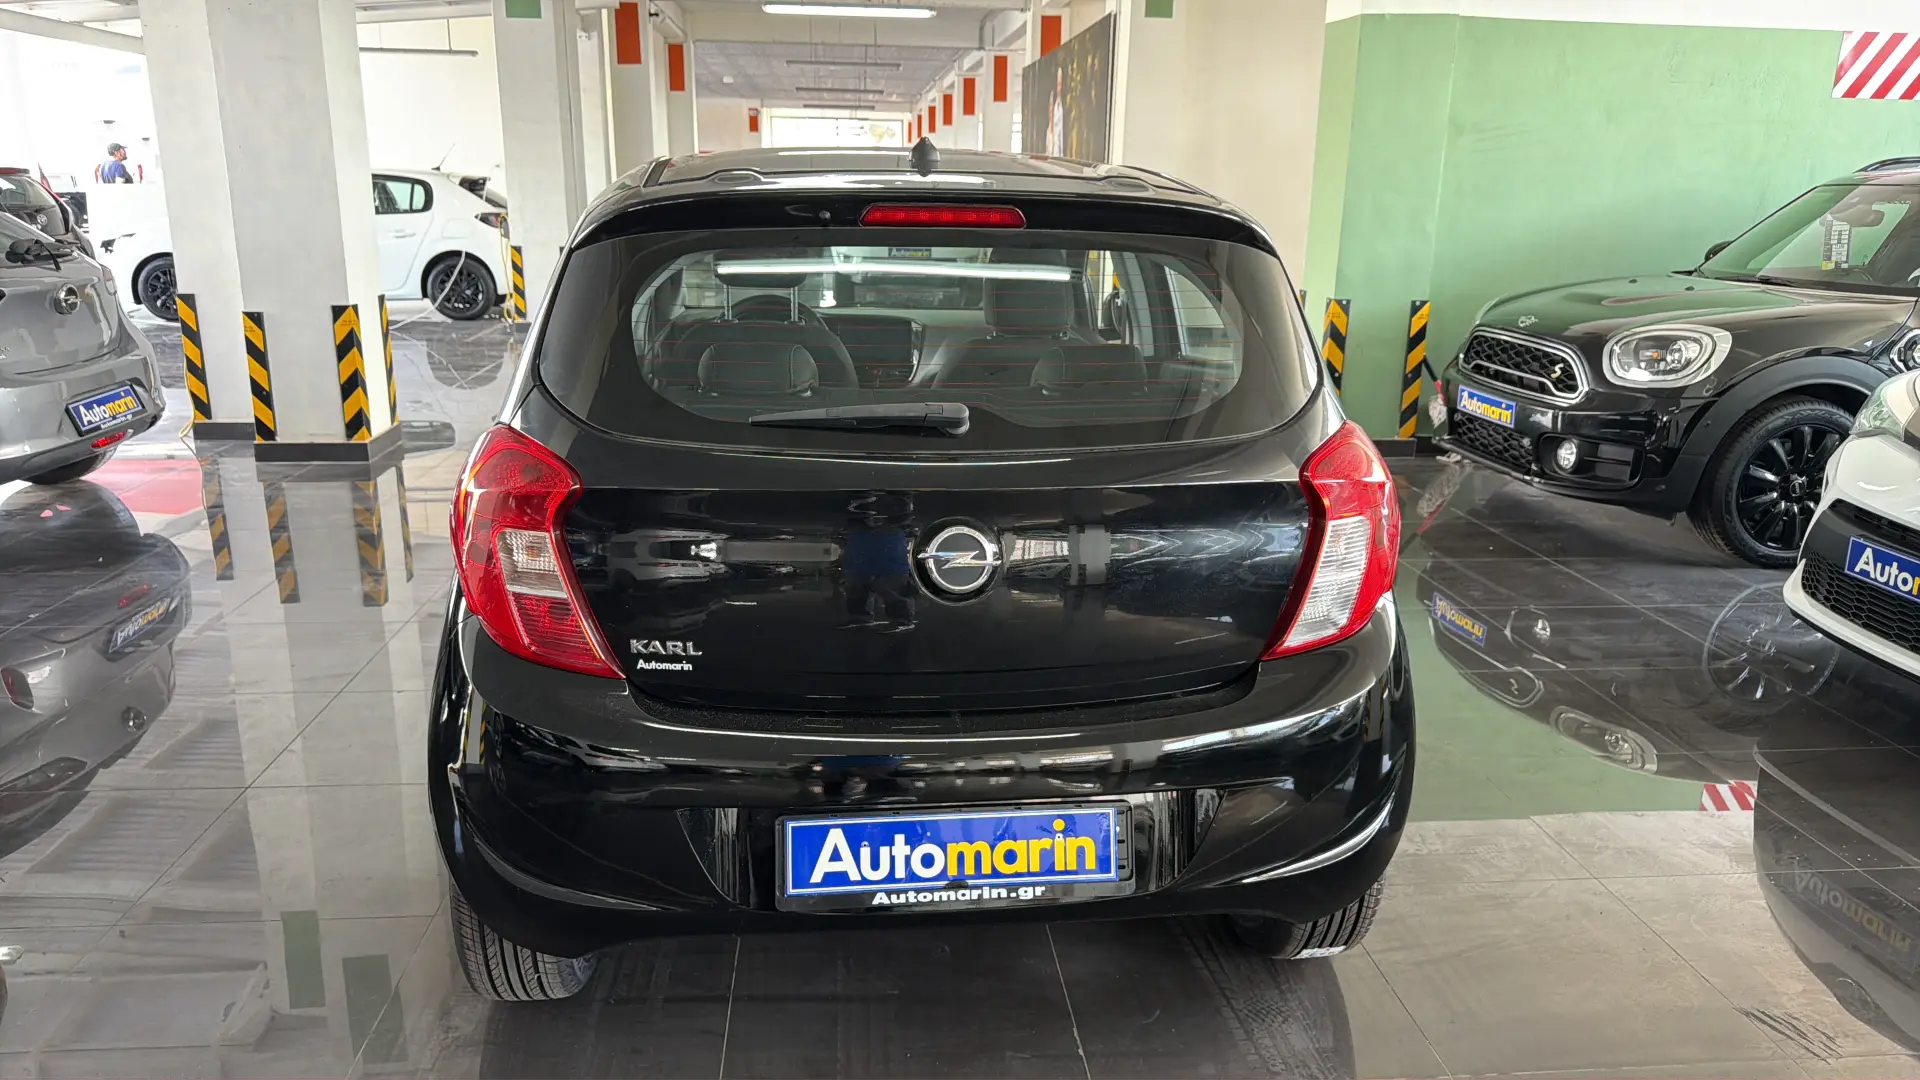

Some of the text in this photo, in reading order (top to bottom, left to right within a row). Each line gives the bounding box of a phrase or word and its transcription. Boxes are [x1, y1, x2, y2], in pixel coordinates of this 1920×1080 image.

[78, 391, 138, 426] Automarin
[1461, 390, 1512, 423] Automarin
[630, 639, 702, 656] KARL
[636, 659, 692, 671] Automarin
[809, 818, 1096, 884] Automarin
[872, 885, 1045, 905] Automarin.gr
